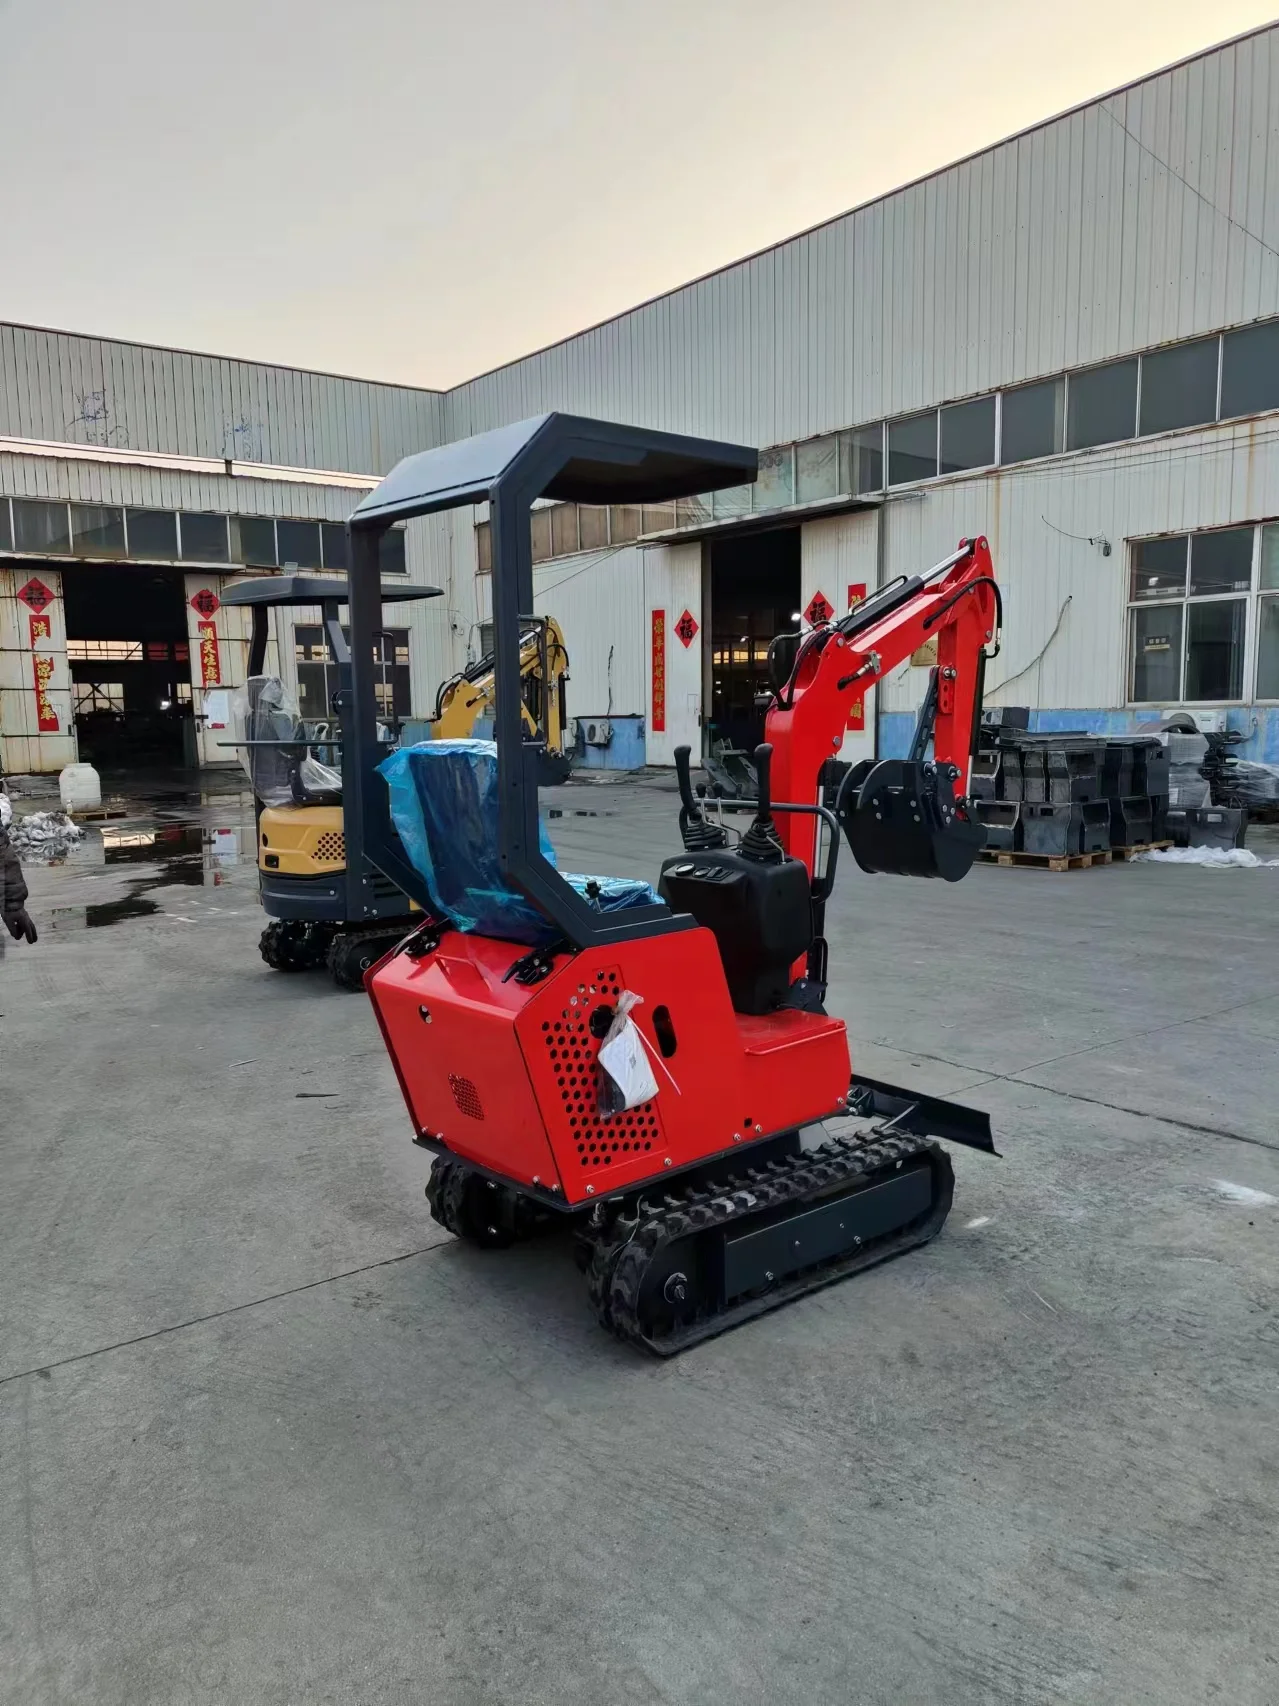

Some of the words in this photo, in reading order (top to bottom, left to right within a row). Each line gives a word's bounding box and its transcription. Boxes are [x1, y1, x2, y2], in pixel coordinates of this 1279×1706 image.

[197, 592, 214, 612] 福
[810, 601, 826, 622] 福
[680, 618, 693, 639] 福
